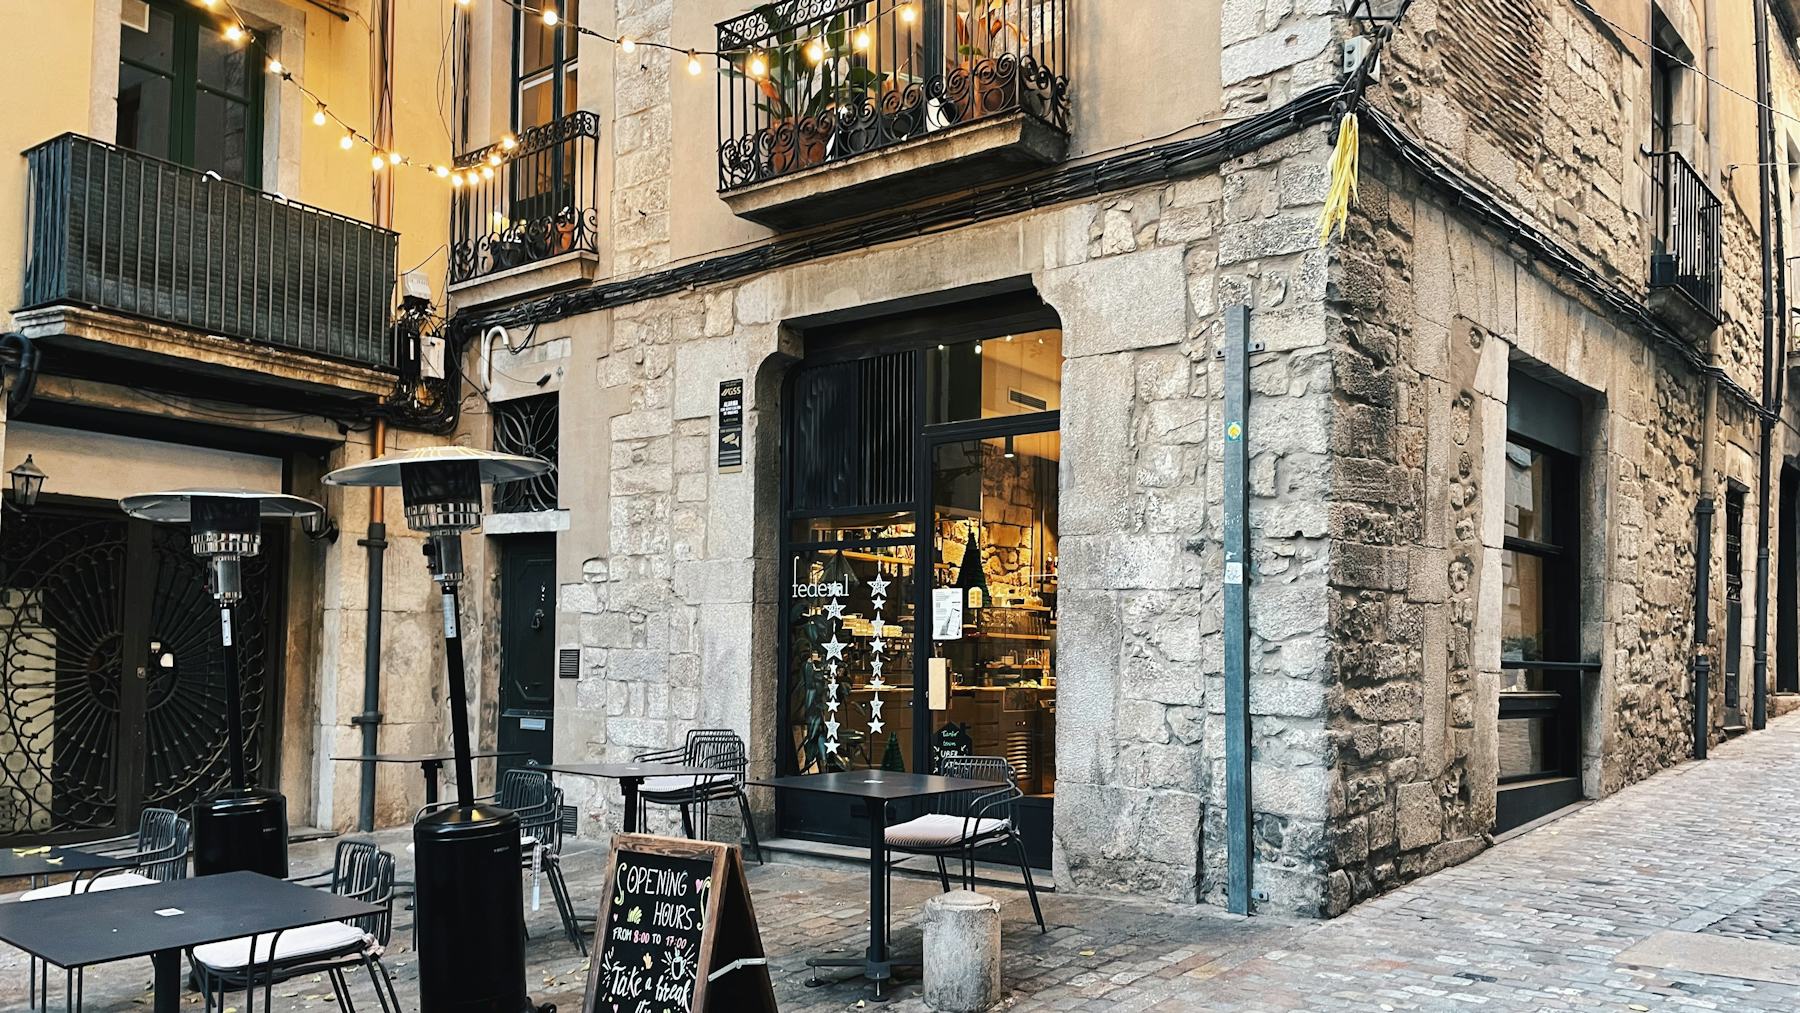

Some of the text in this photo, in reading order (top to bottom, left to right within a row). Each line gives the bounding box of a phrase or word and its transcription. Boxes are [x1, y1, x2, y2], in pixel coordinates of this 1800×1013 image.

[792, 556, 850, 598] federal
[626, 865, 689, 897] OPENING
[652, 900, 696, 931] HOURS
[612, 926, 688, 949] FROM 8:00 TO 17:00
[611, 965, 643, 998] Take
[645, 976, 653, 991] a
[655, 974, 692, 1013] break
